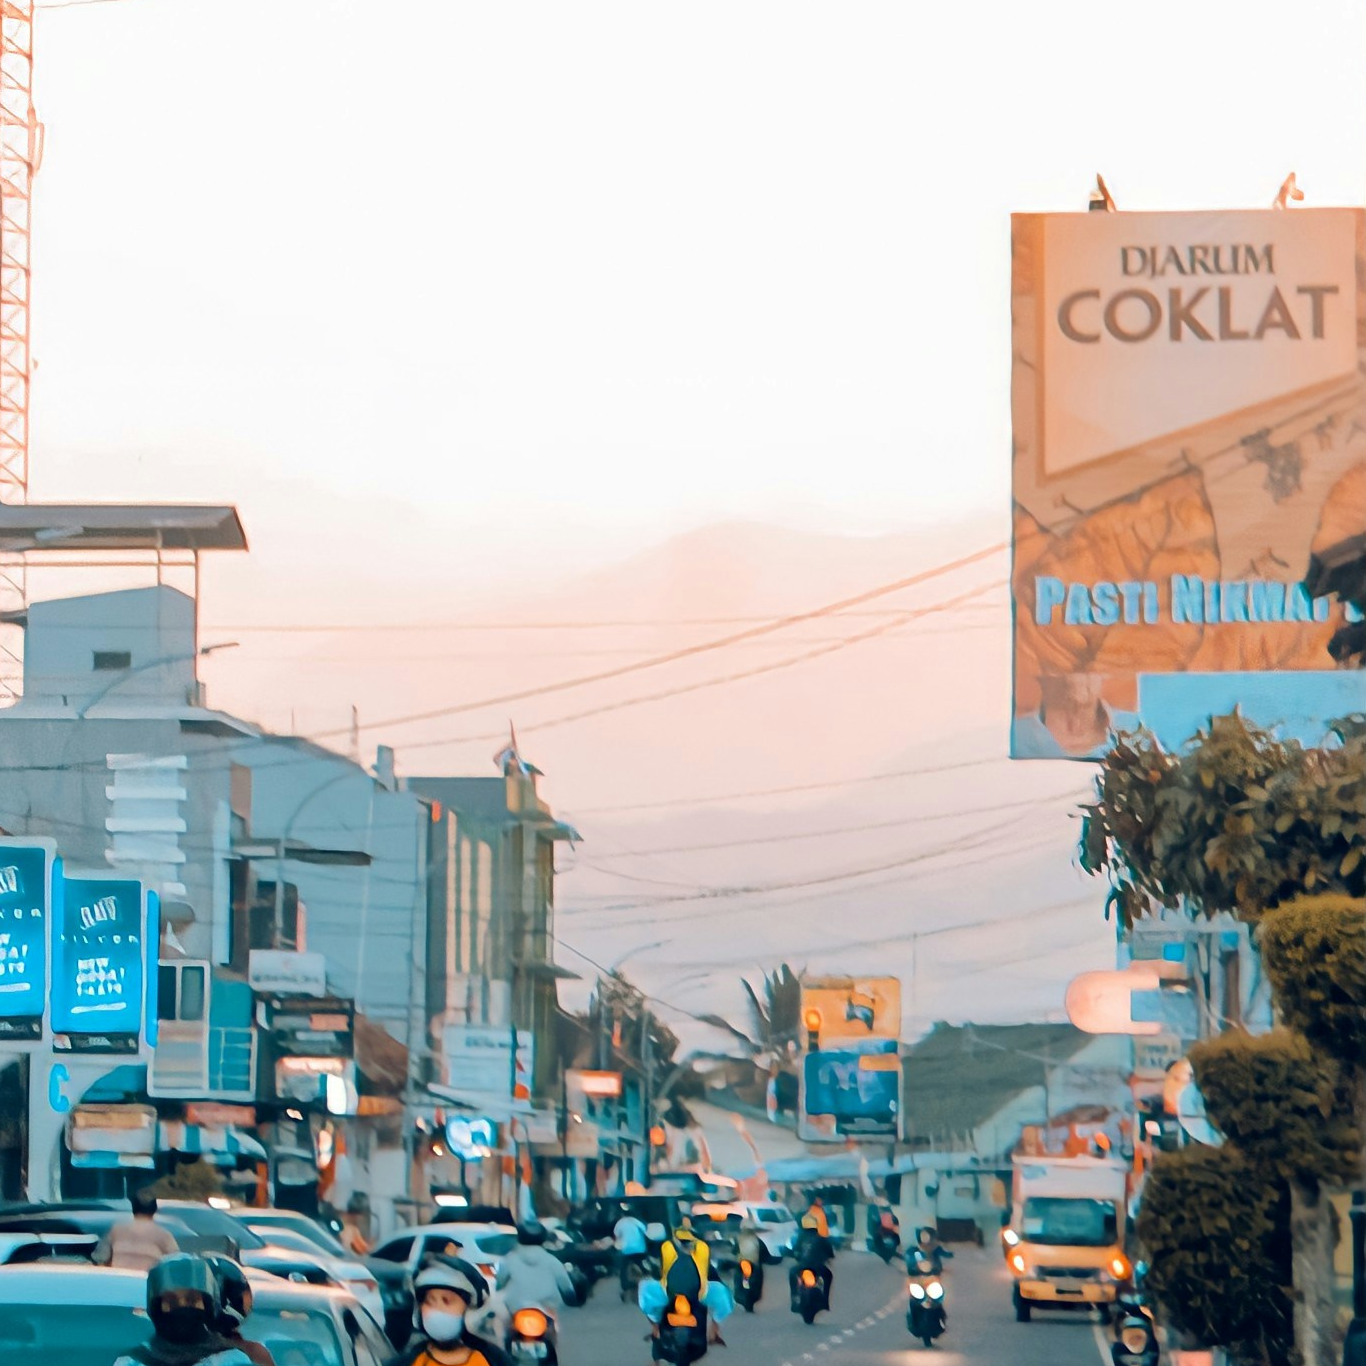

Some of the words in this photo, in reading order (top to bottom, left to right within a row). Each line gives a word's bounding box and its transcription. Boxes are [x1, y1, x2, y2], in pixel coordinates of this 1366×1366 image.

[1121, 244, 1276, 279] DJARUM
[1057, 285, 1339, 344] COKLAT
[1035, 575, 1159, 626] PASTI
